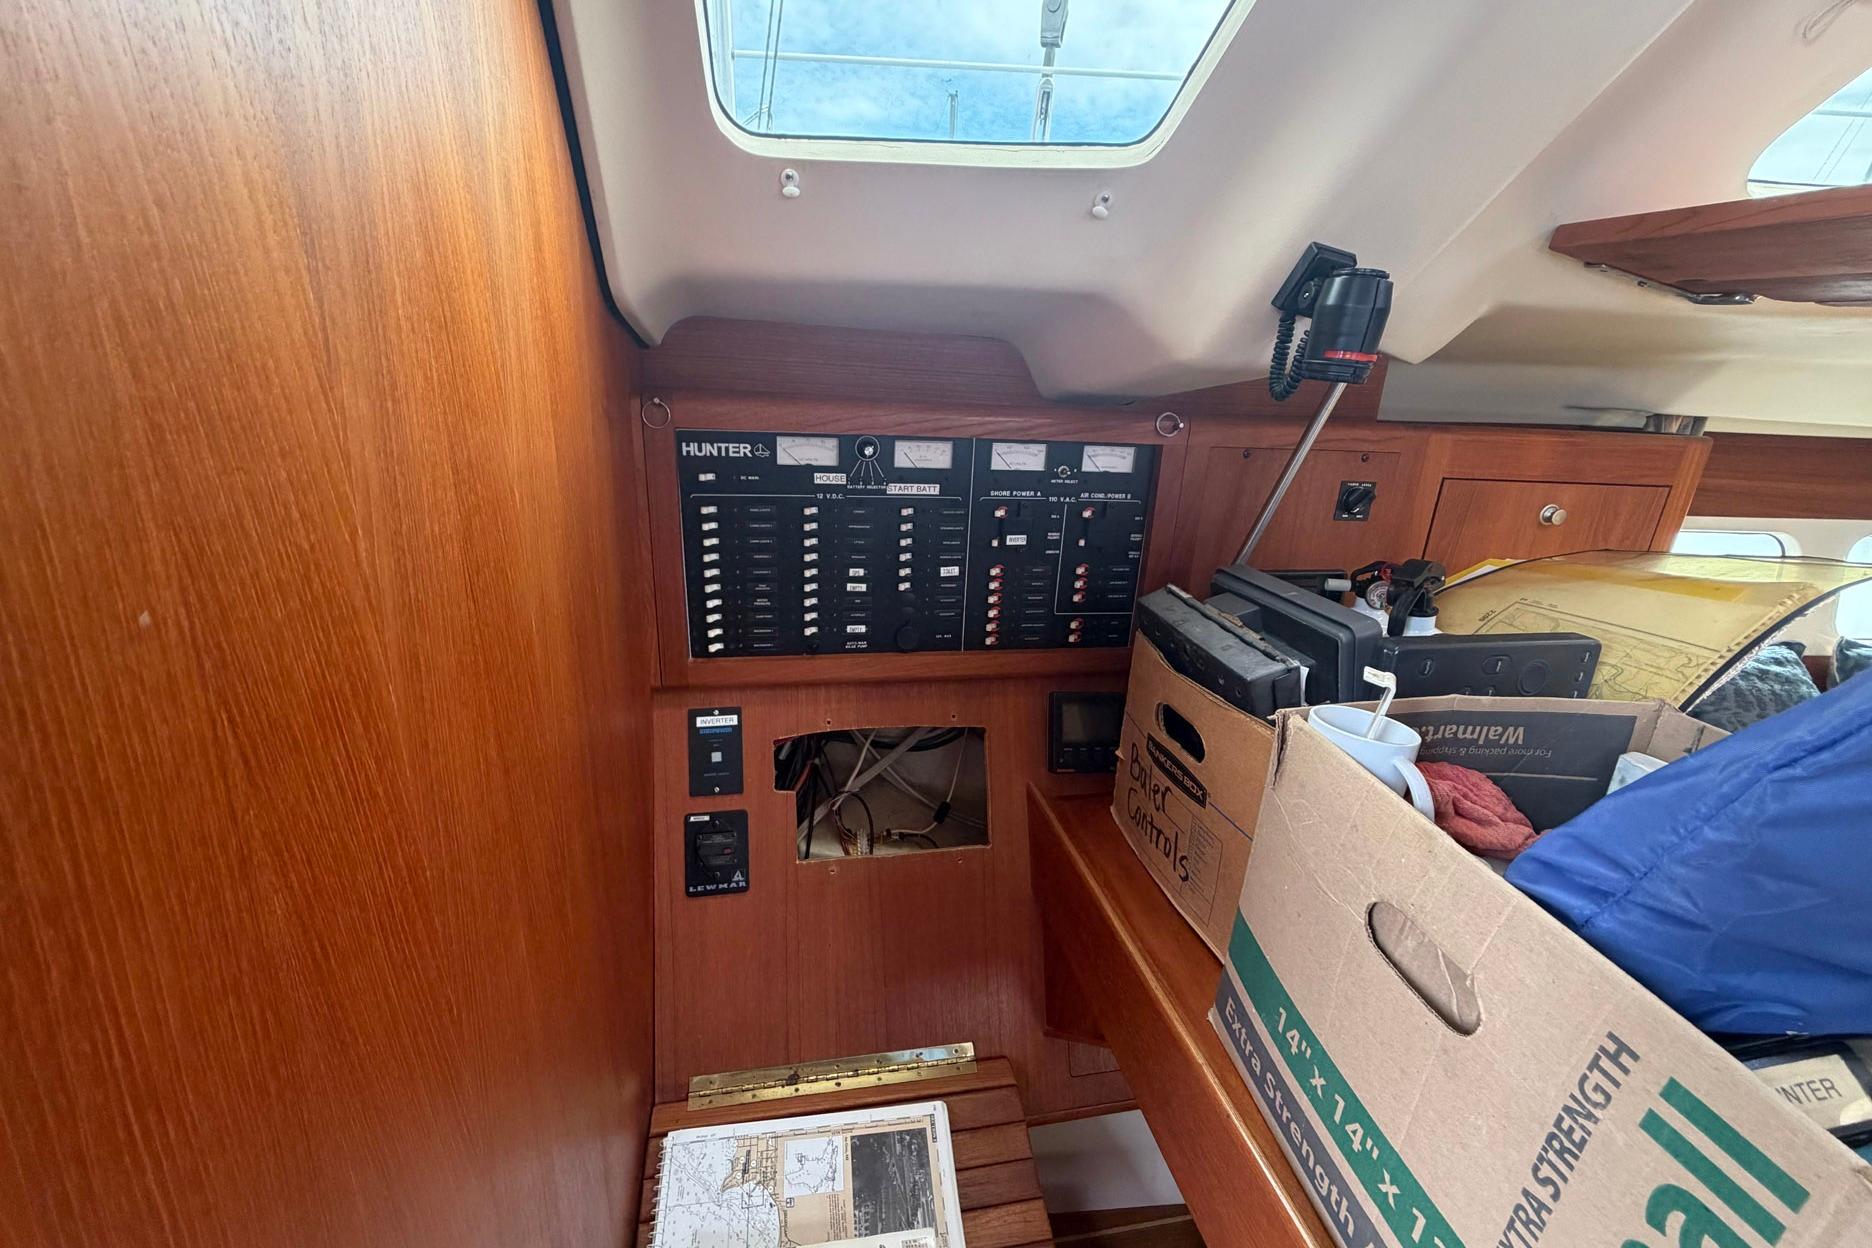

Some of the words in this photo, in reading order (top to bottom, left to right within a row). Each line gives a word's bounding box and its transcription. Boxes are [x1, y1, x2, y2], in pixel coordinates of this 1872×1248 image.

[682, 442, 752, 457] HUNTER
[815, 474, 845, 483] HOUSE
[887, 484, 914, 493] START
[700, 716, 734, 725] INVERTER
[1469, 746, 1507, 757] packing
[1536, 748, 1552, 758] For
[1149, 743, 1184, 782] BANKERS
[1183, 776, 1205, 800] BOX
[1127, 787, 1189, 882] Controls
[689, 881, 747, 893] LEWMAR
[1776, 1078, 1843, 1105] NTER
[1224, 996, 1262, 1077] Extra
[1263, 1072, 1355, 1240] Strength
[1277, 1006, 1313, 1059] 14"
[1309, 1064, 1327, 1099] x
[1332, 1093, 1380, 1161] 14"
[1377, 1168, 1401, 1211] x
[1411, 1207, 1446, 1248] 1
[1530, 1030, 1642, 1203] STRENGTH
[1621, 1076, 1811, 1248] all
